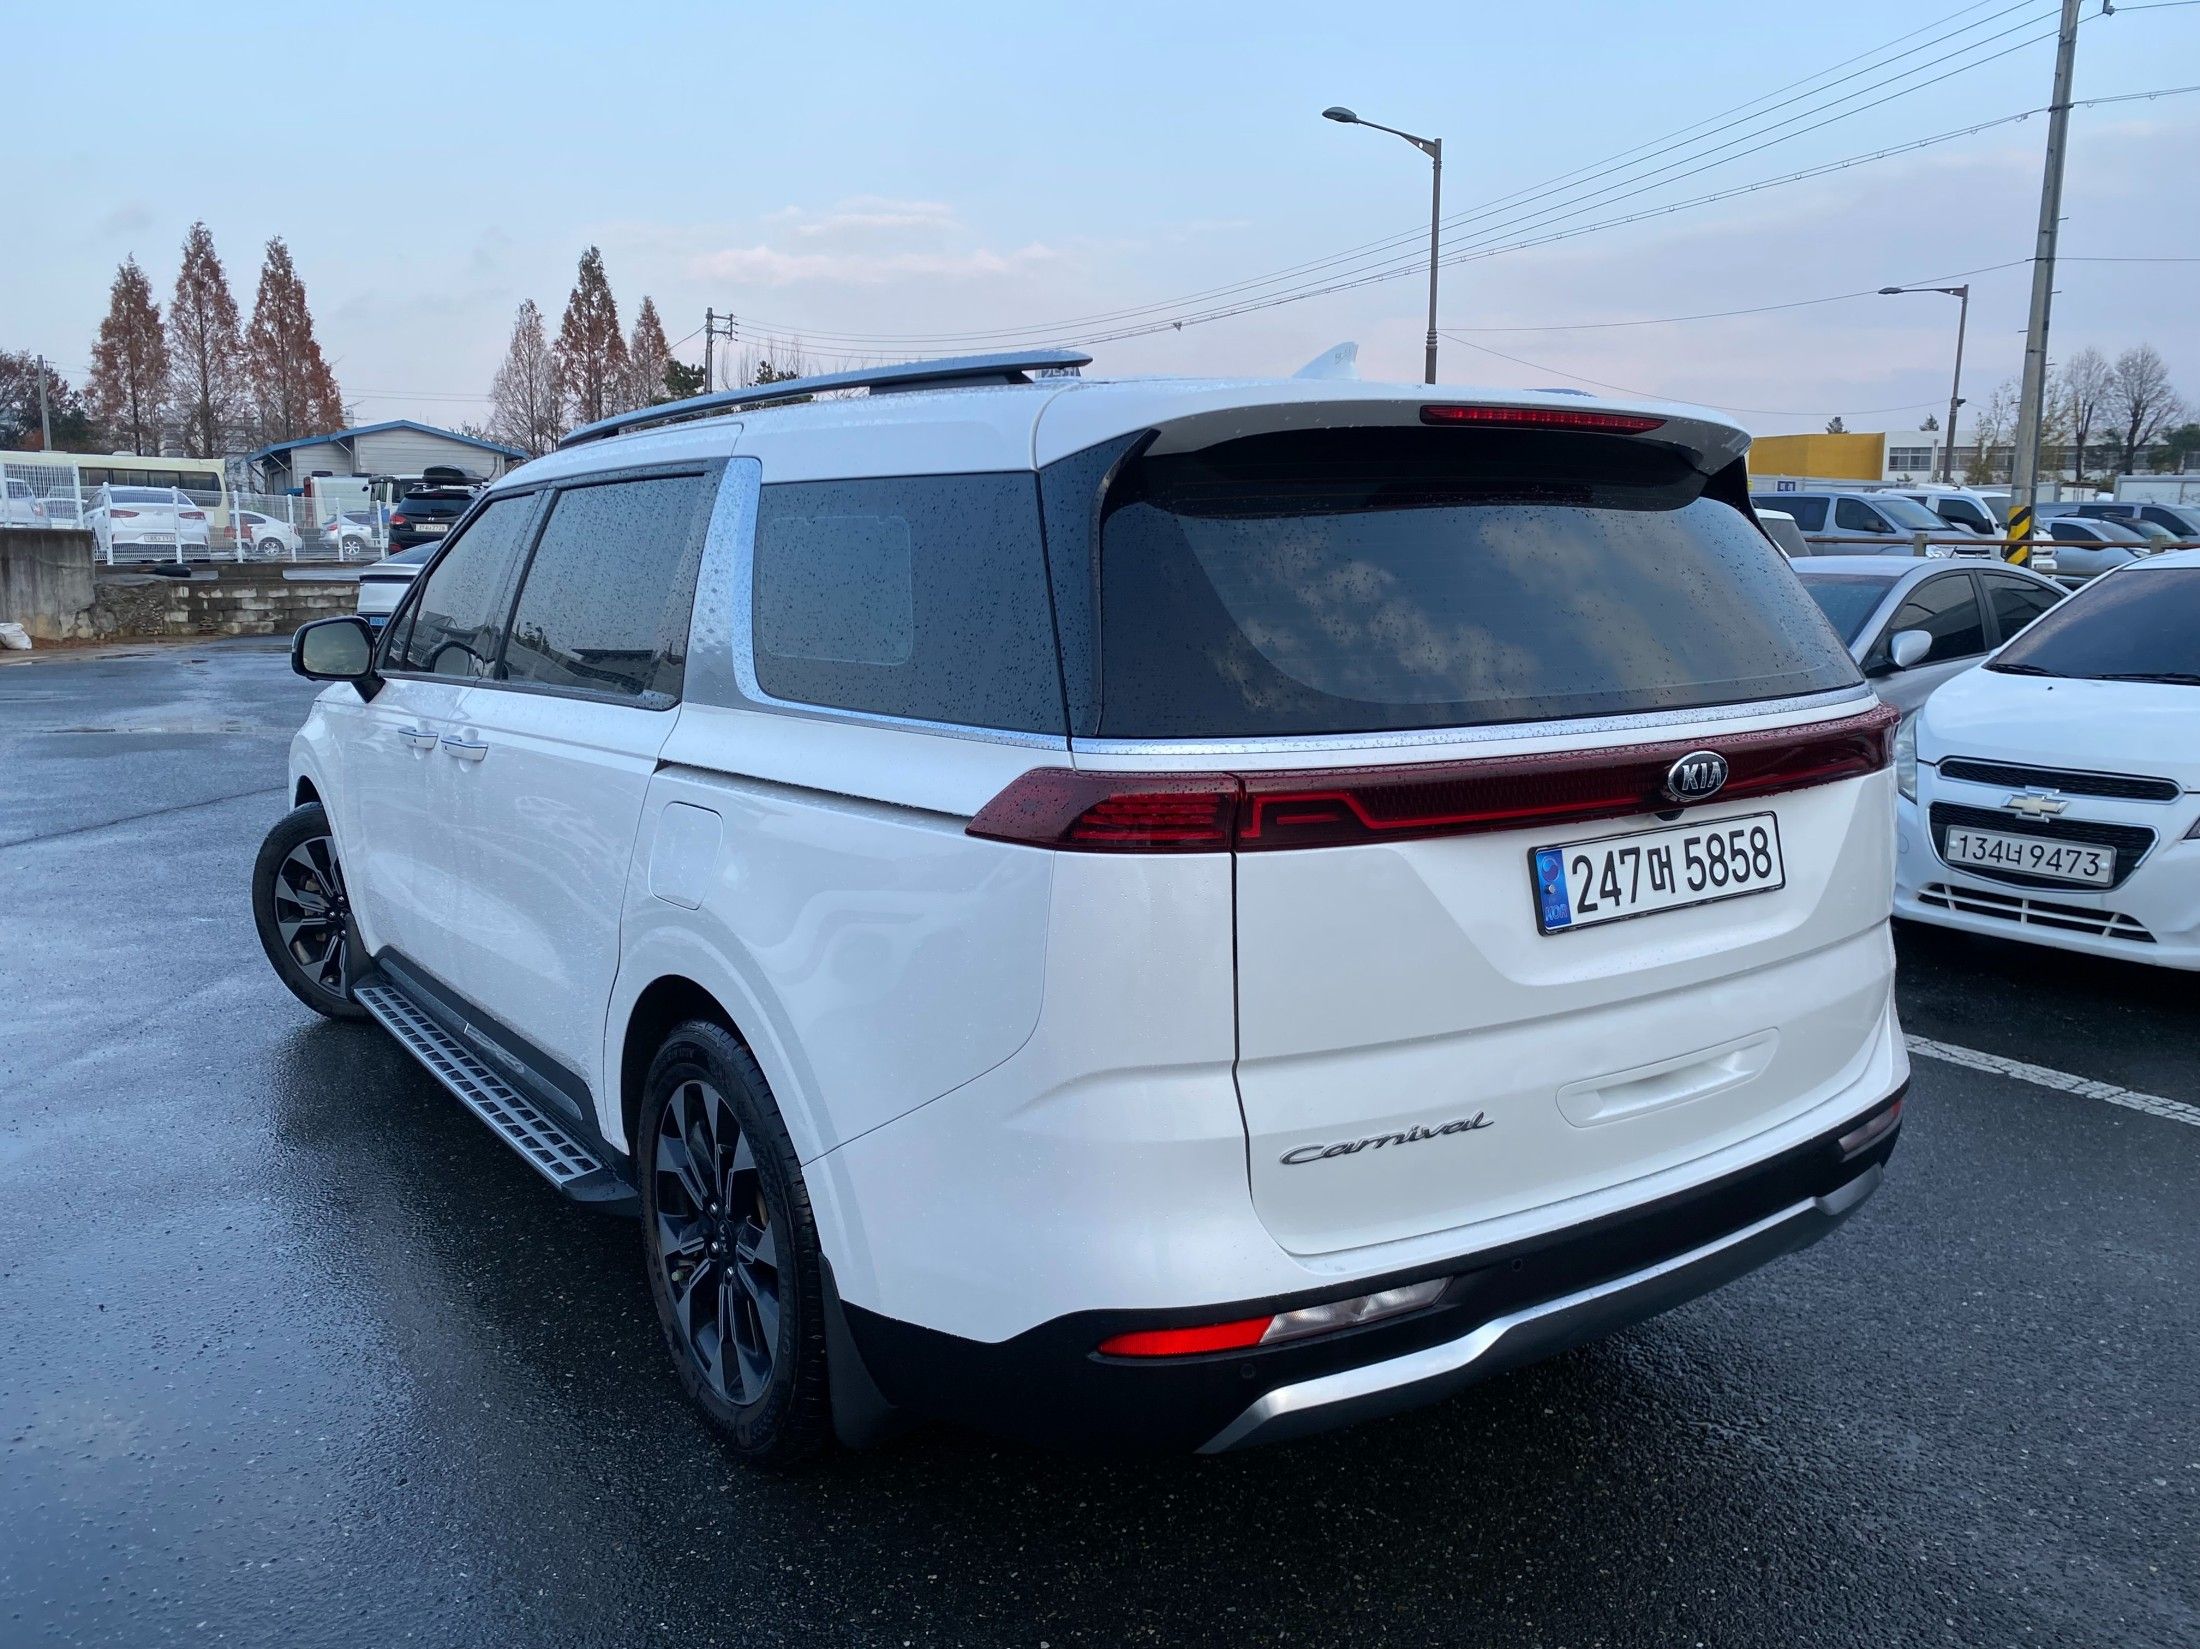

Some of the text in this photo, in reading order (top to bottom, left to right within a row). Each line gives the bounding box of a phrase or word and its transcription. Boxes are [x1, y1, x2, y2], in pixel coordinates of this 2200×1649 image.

[1682, 761, 1722, 791] KIA
[1572, 825, 1772, 914] 247머 5858
[1960, 835, 2101, 876] 134너 9473
[1278, 1110, 1495, 1165] Carnival
